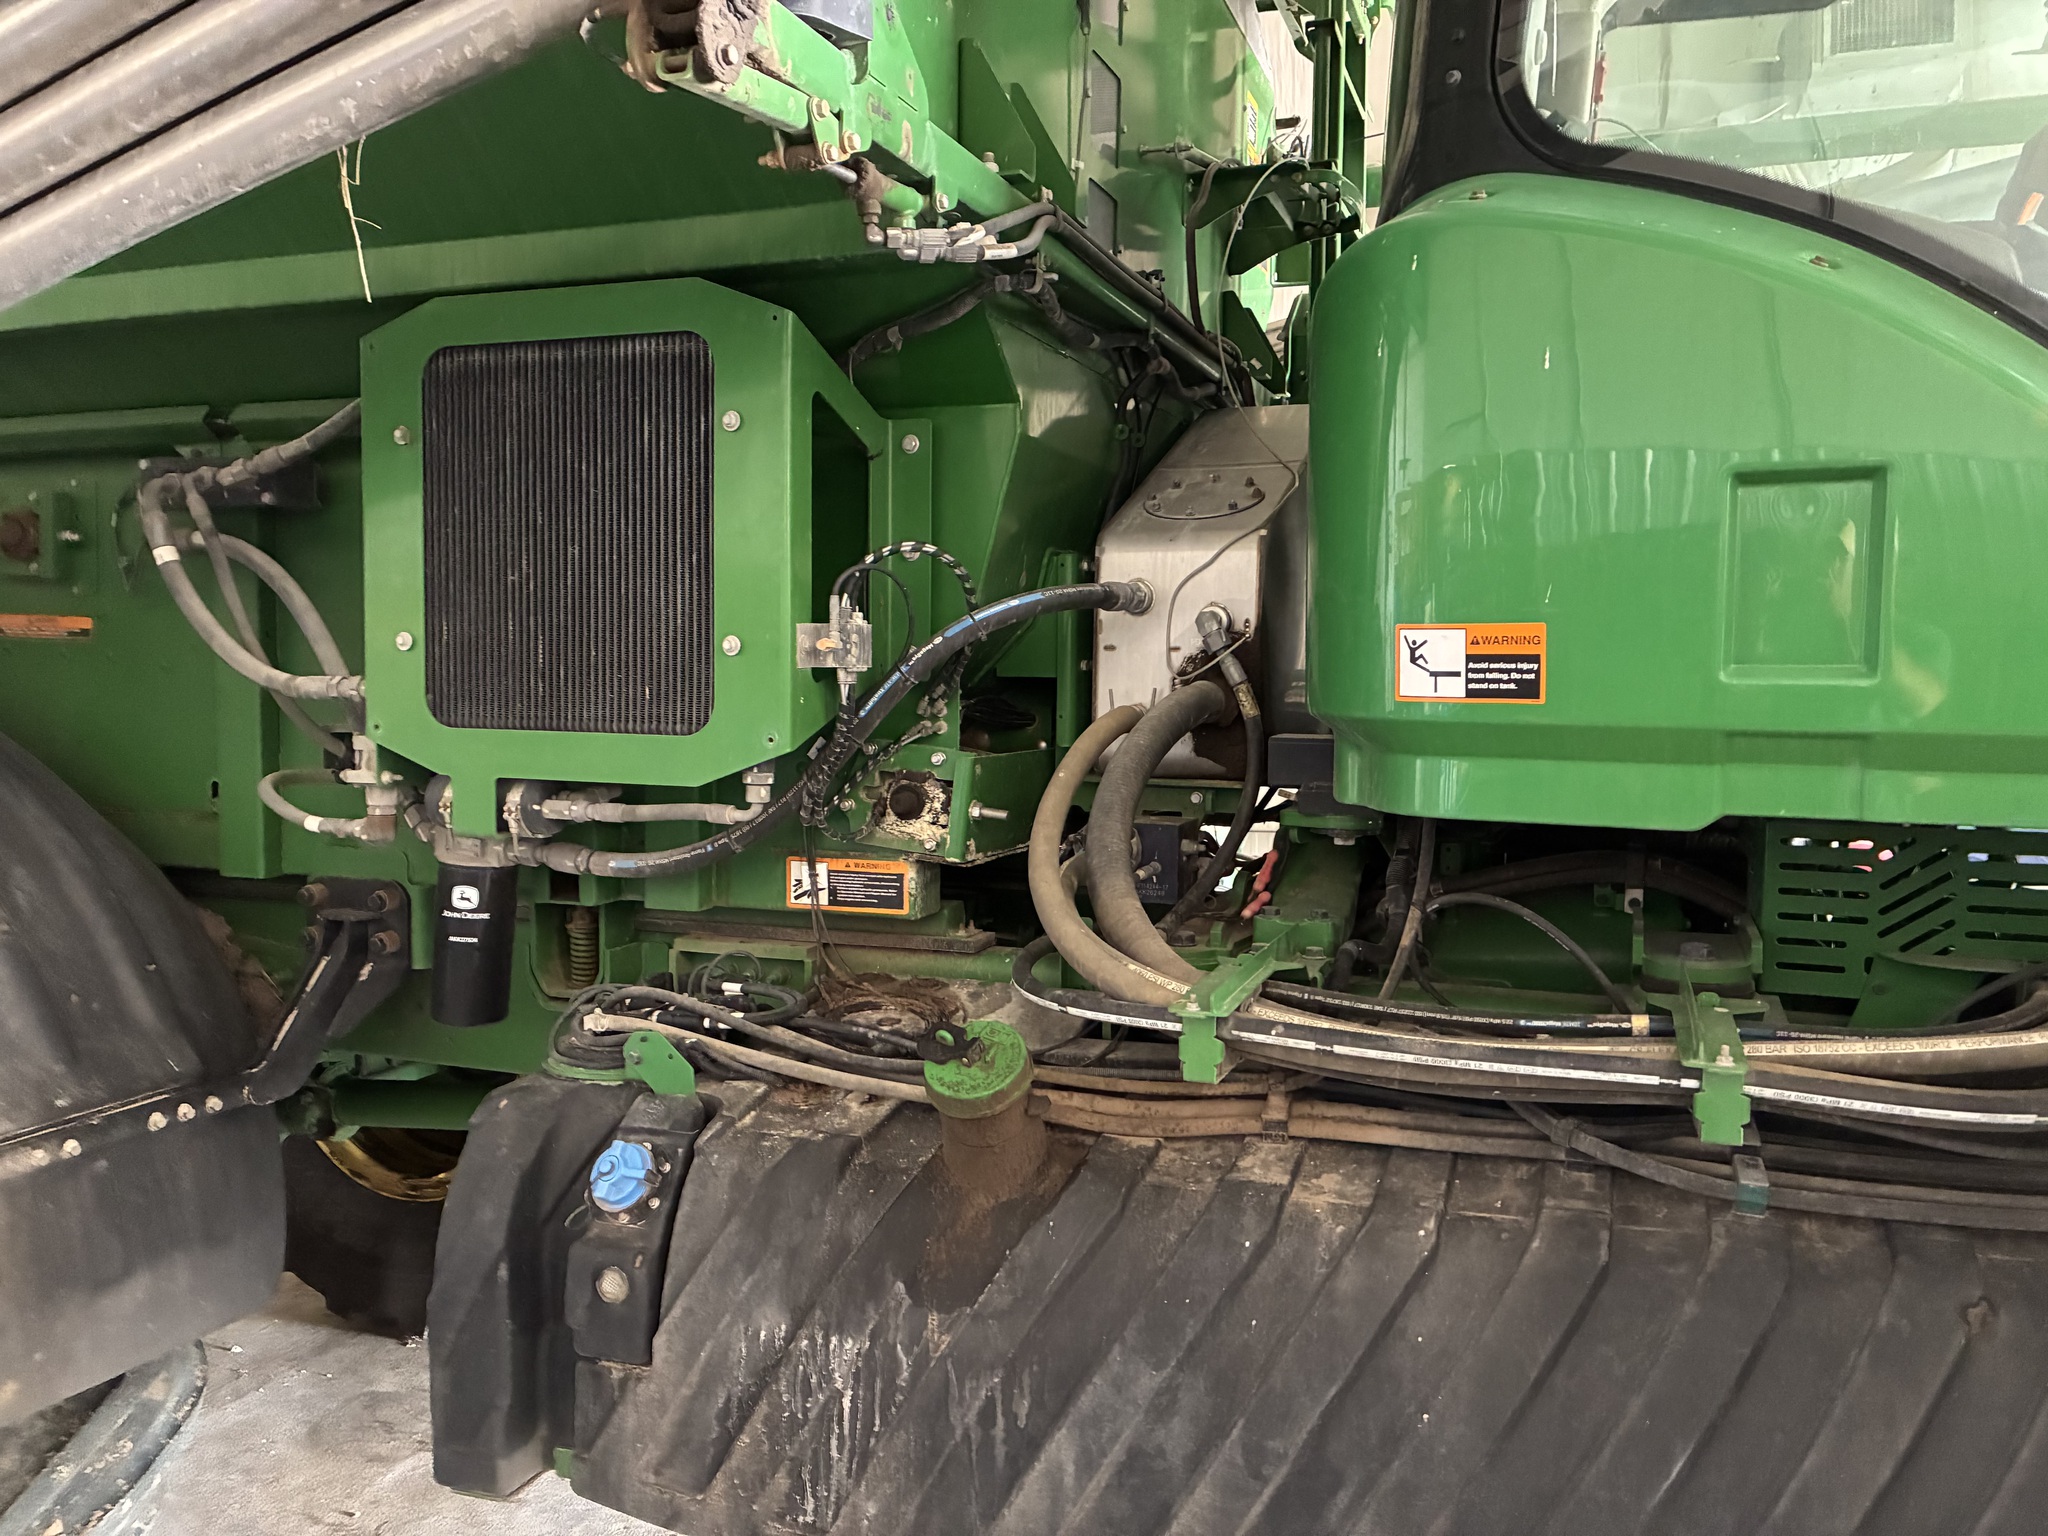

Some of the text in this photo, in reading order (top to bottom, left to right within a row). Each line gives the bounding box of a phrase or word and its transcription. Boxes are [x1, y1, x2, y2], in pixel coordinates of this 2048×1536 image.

[1480, 636, 1541, 645] WARNING
[1517, 662, 1538, 670] injury
[854, 861, 891, 870] WARNING
[442, 910, 490, 919] JOHN DEERE
[1257, 1008, 1295, 1022] EXCEEDS
[1765, 1045, 1786, 1053] BAR
[1793, 1045, 1809, 1053] ISO
[1866, 1039, 1914, 1051] EXCEEDS
